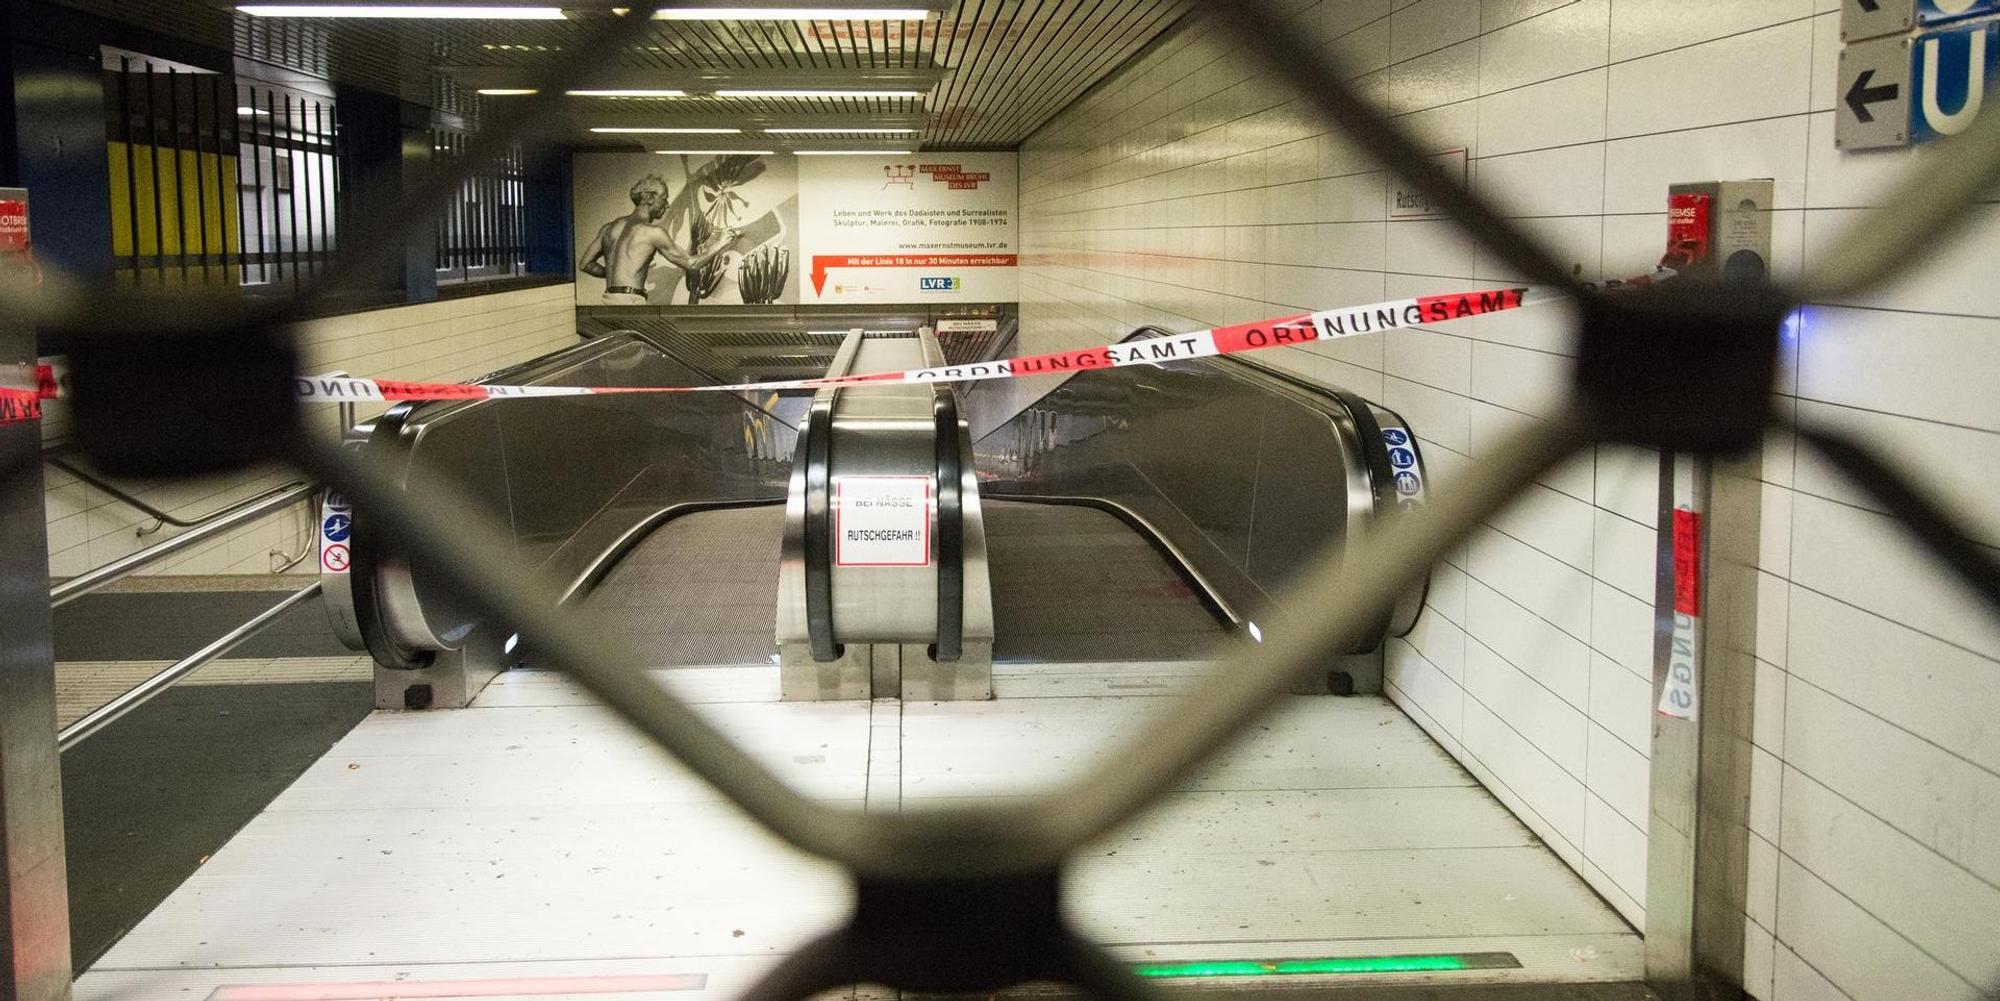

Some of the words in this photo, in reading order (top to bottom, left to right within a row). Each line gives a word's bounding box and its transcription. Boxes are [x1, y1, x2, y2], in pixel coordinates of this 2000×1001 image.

[1922, 30, 1986, 135] U
[834, 209, 857, 217] Leben
[858, 209, 872, 217] und
[873, 209, 892, 217] Werk
[894, 209, 907, 217] des
[909, 209, 945, 217] Dadaisten
[947, 209, 961, 217] und
[962, 209, 1008, 217] Surrealisten
[929, 219, 967, 227] Fotografie
[848, 257, 859, 265] Mit
[861, 257, 874, 265] der
[875, 257, 893, 265] Linie
[905, 257, 913, 265] in
[914, 257, 927, 265] nur
[928, 257, 938, 265] 30
[939, 257, 968, 265] Minuten
[970, 257, 1009, 265] erreichbar
[922, 279, 945, 288] LVR
[1246, 287, 1529, 349] ORDNUNGSAMT
[876, 495, 913, 508] NÄSSE
[847, 529, 913, 541] RUTSCHGEFAHR
